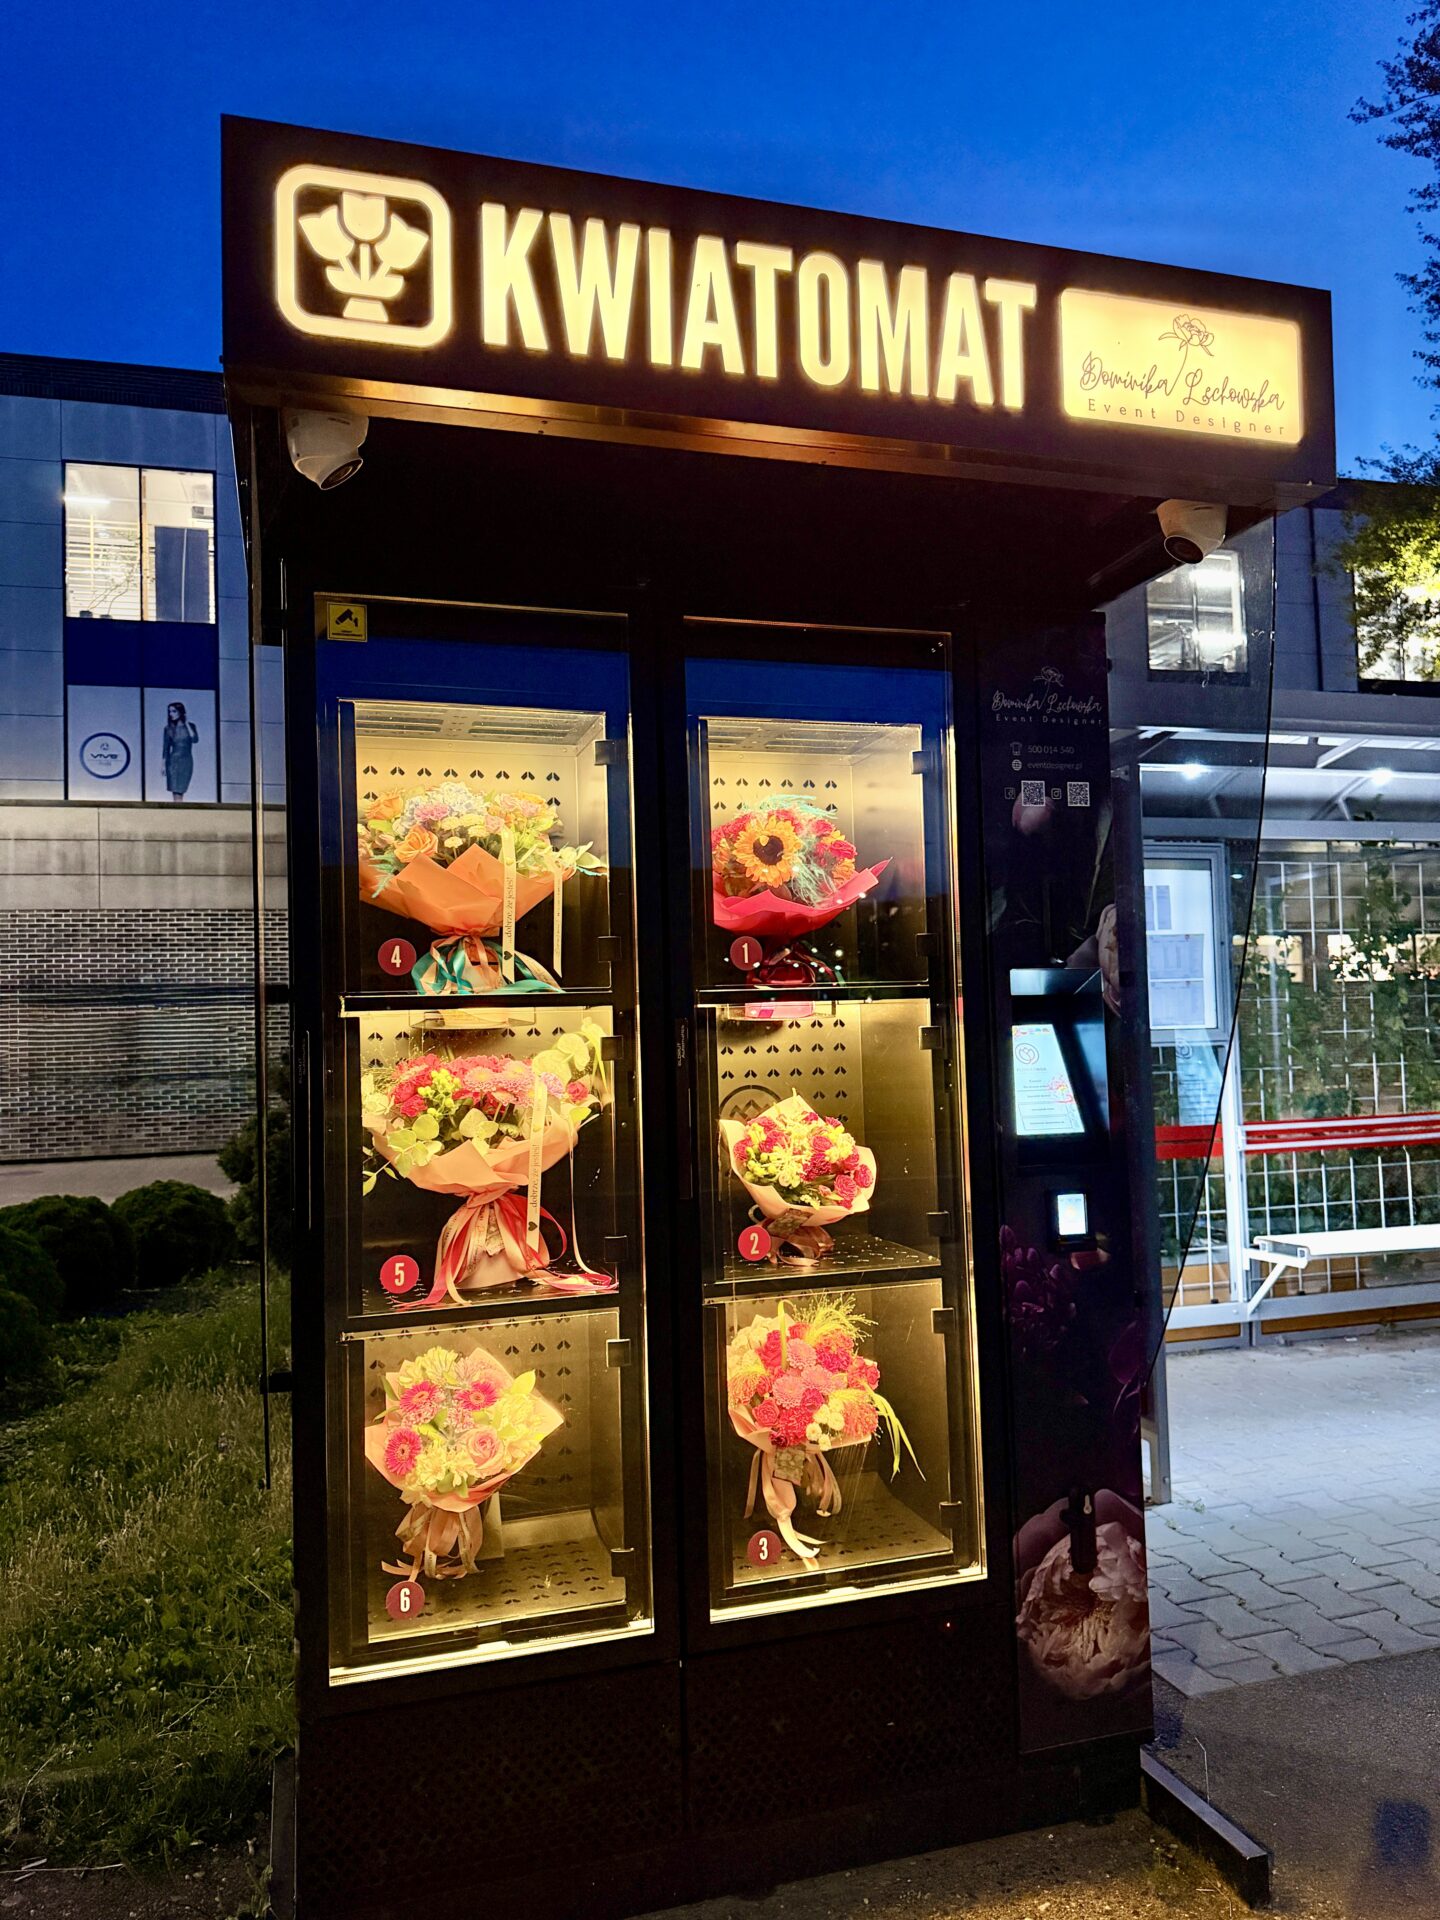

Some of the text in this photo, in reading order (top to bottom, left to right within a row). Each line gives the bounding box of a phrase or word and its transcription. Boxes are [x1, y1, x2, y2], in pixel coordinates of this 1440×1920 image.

[481, 202, 1036, 410] KWIATOMAT
[1079, 351, 1173, 399] Dominika
[1088, 398, 1285, 435] Event Designer
[992, 690, 1041, 712] Dominika
[995, 713, 1102, 726] Event Designer
[1027, 745, 1042, 754] 500
[390, 945, 401, 968] 4
[741, 942, 749, 964] 1
[750, 1233, 760, 1254] 2
[394, 1262, 405, 1287] 5
[759, 1536, 769, 1561] 3
[400, 1587, 411, 1613] 6
